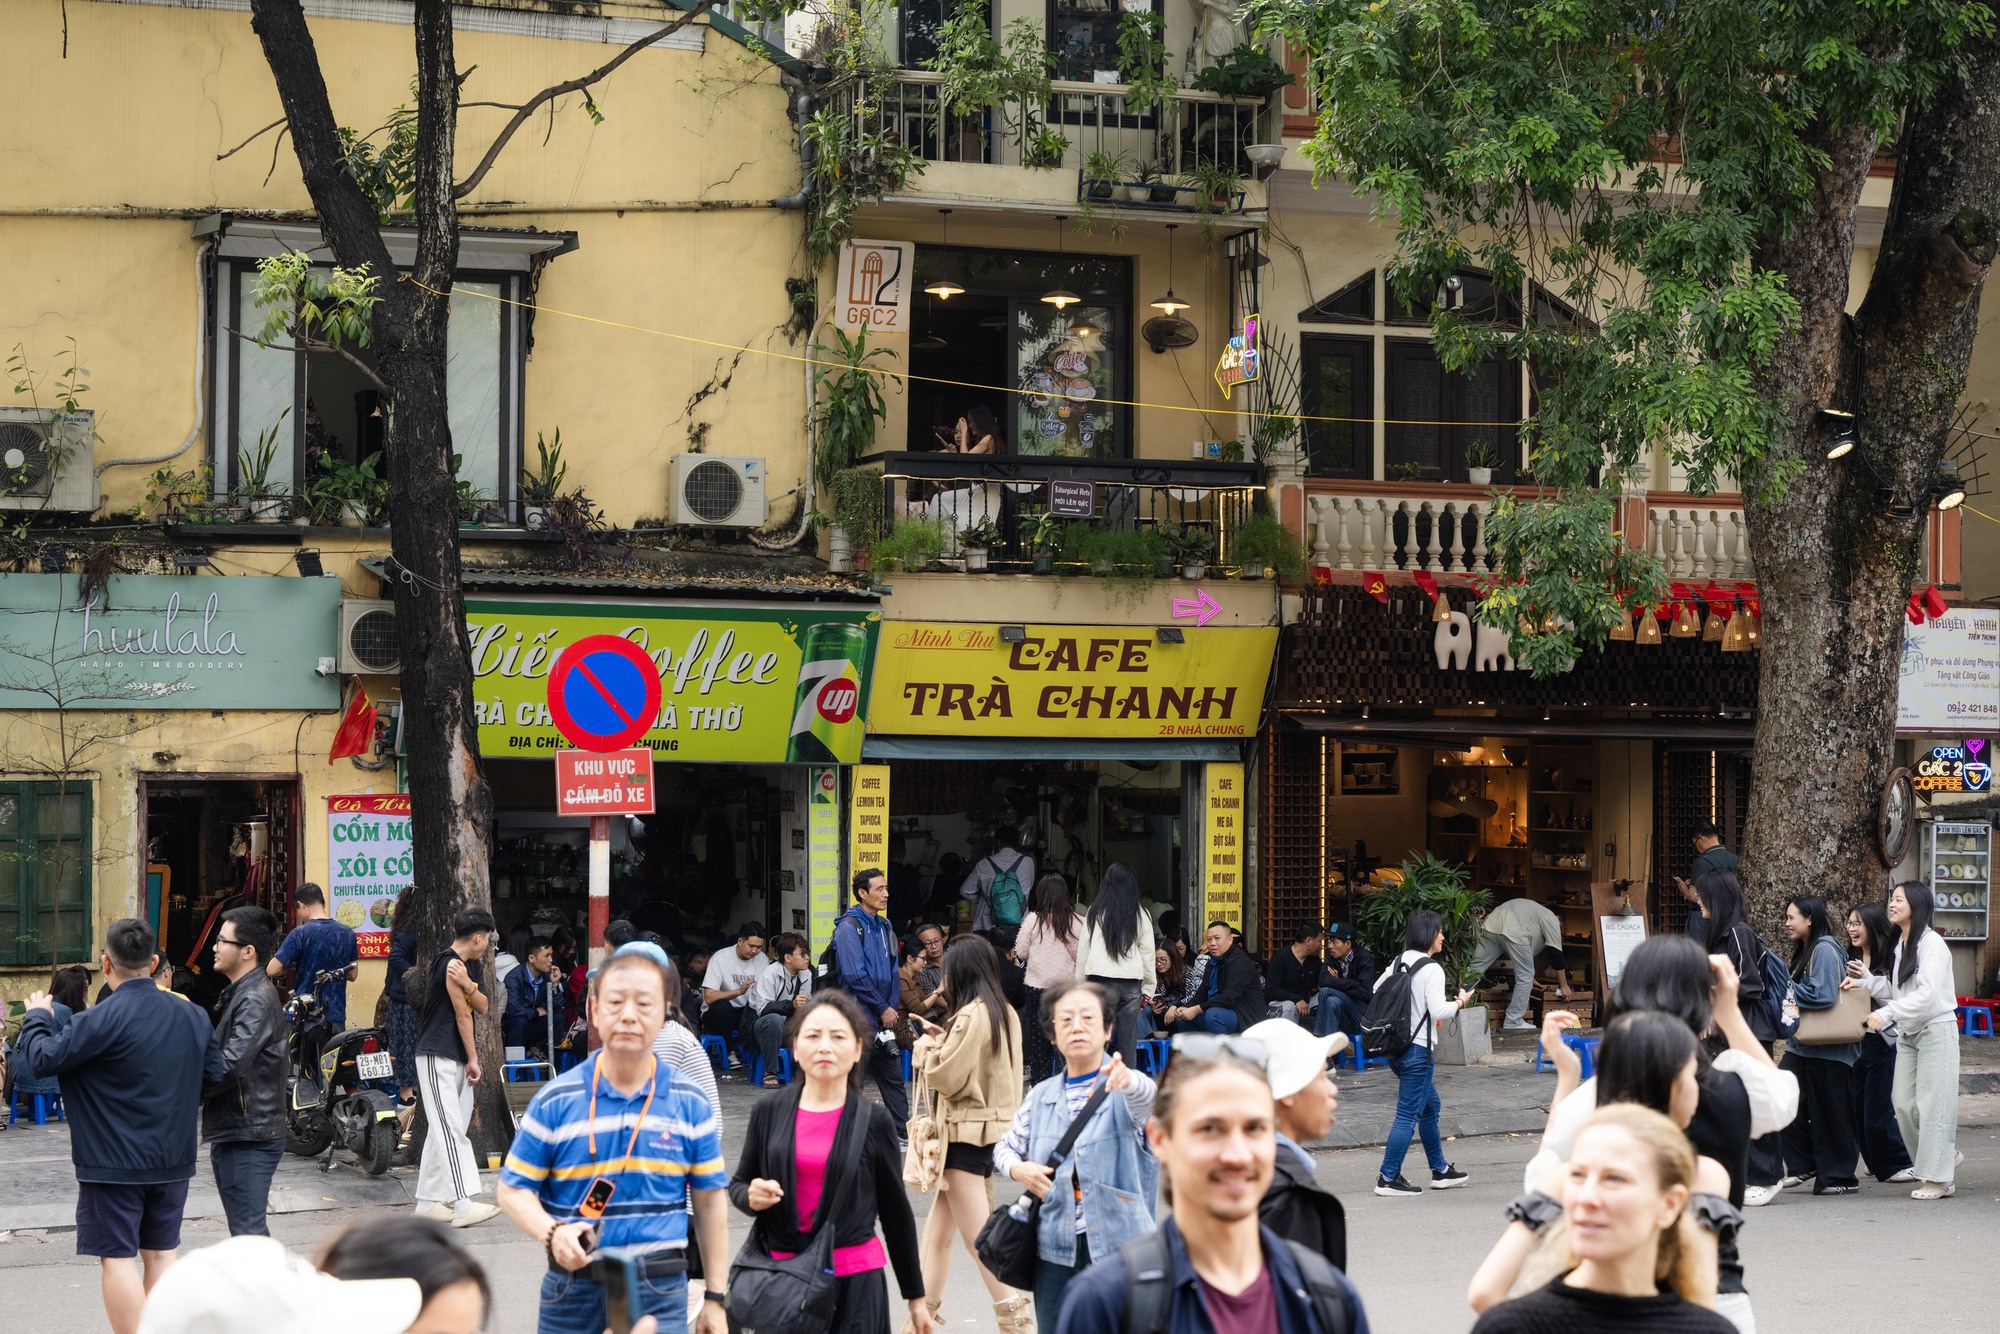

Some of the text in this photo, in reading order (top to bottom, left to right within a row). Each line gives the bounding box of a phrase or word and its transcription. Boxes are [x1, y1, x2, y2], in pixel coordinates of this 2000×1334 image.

[72, 585, 246, 656] huulala
[895, 628, 952, 647] Minh
[617, 625, 779, 695] offee
[1008, 638, 1152, 673] CAFE
[80, 661, 244, 670] HAND EMBROIDERY
[1946, 656, 1952, 665] và
[1962, 656, 1976, 668] dùng
[1962, 670, 1977, 681] Công
[1978, 671, 1990, 681] Giáo
[903, 676, 1238, 721] TRÀ CHANH
[474, 696, 506, 726] RÀ
[1968, 704, 1981, 713] 421
[1983, 704, 1998, 714] 848
[688, 701, 744, 731] THỜ
[1159, 723, 1245, 735] 2B NHÀ CHUNG
[509, 737, 532, 750] ĐỊA
[536, 734, 564, 748] CHỈ:
[1933, 747, 1963, 759] OPEN
[574, 758, 636, 778] KHU VỰC
[1919, 757, 1963, 777] GÁC 2
[862, 778, 880, 789] COFFEE
[1219, 779, 1232, 790] CAFE
[1914, 776, 1963, 791] COFFEE
[566, 782, 645, 805] CẤM ĐỖ XE
[333, 801, 362, 812] Cô
[856, 796, 885, 807] LEMON TEA
[1222, 797, 1239, 808] CHANH
[860, 815, 881, 826] TAPIOCA
[1217, 816, 1225, 827] ME
[858, 833, 882, 844] STARLING
[859, 852, 880, 863] APRICOT
[338, 851, 378, 878] XÔI
[334, 882, 365, 896] CHUYÊN
[367, 881, 383, 896] CÁC
[1208, 892, 1225, 903] CHANH
[1208, 910, 1226, 922] CHANH
[360, 945, 381, 955] 093
[362, 1065, 391, 1078] 460.23
